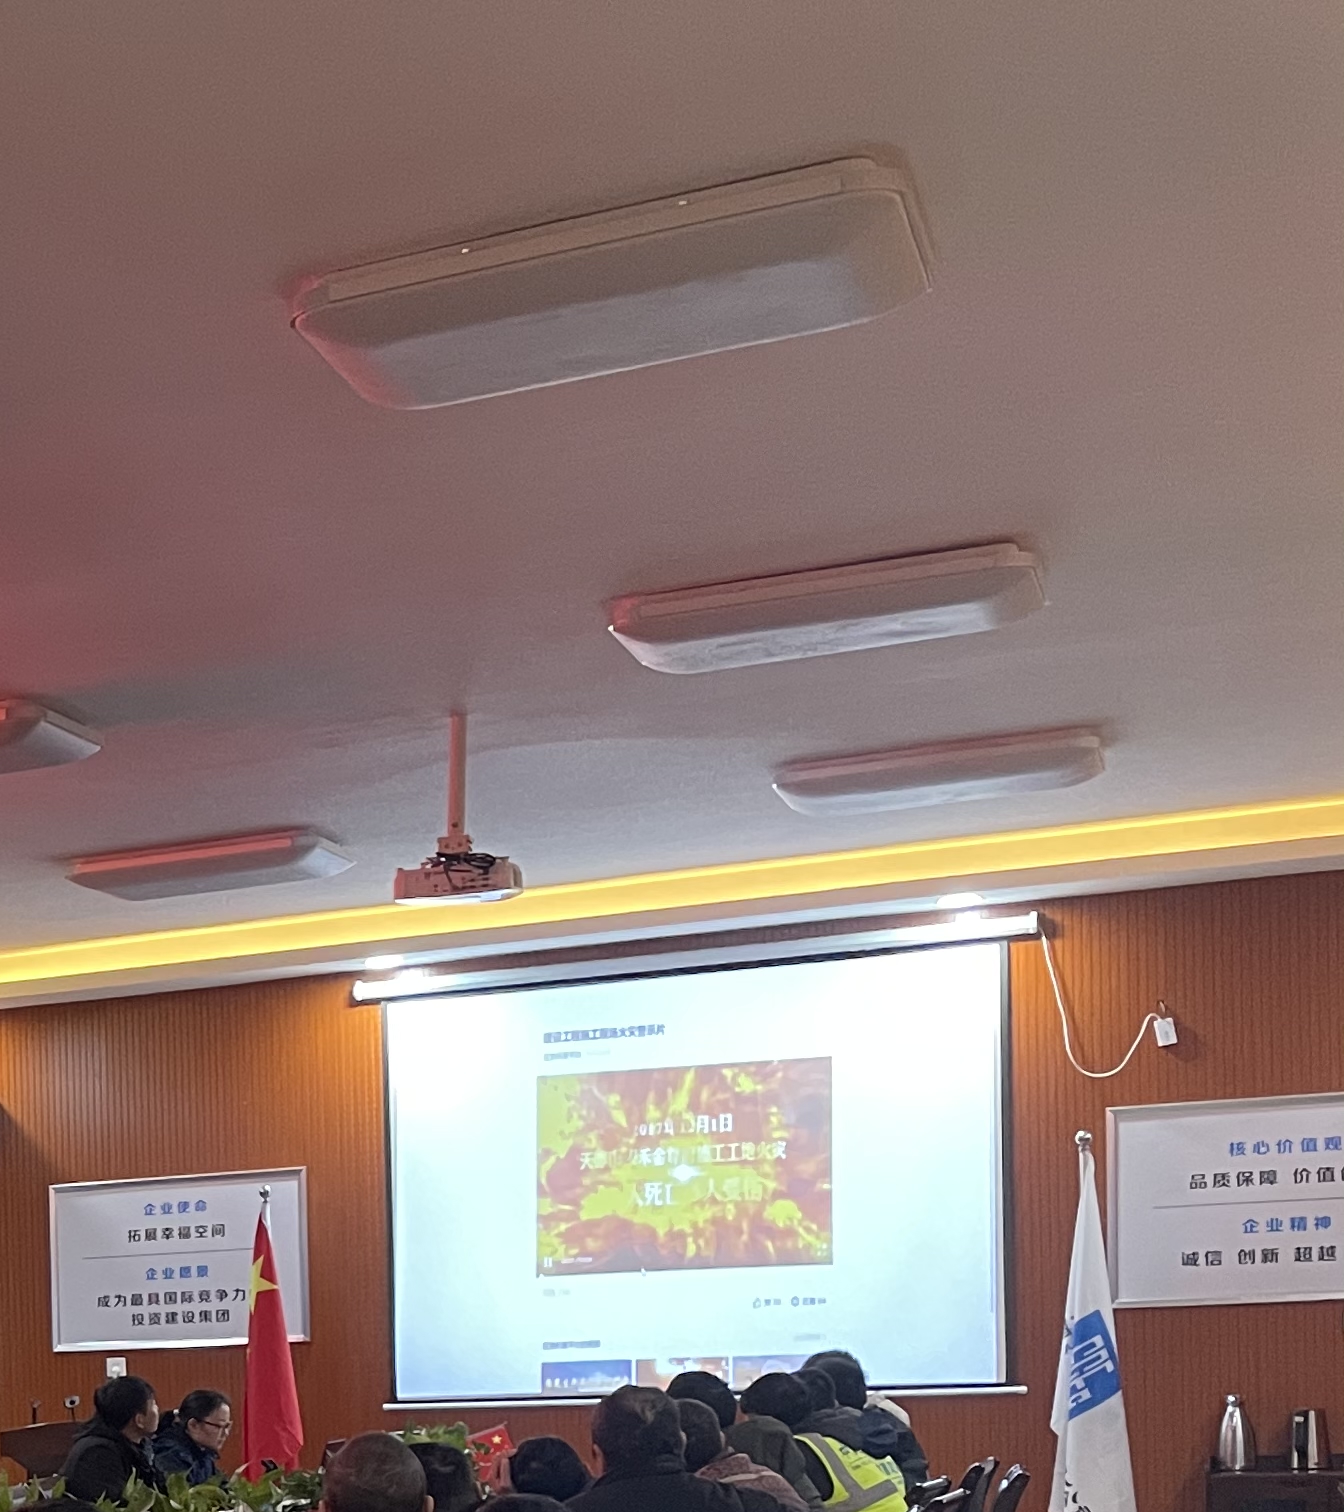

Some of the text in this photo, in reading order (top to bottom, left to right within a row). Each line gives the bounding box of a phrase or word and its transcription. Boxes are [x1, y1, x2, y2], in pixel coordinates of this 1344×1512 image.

[1228, 1136, 1342, 1157] 核心价值观
[1189, 1167, 1344, 1190] 品质保障 价值
[143, 1200, 208, 1216] 企业使命
[127, 1223, 226, 1243] 拓展幸福空间
[1242, 1215, 1332, 1234] 企业精神
[1181, 1245, 1337, 1267] 诚信 创新 超越
[145, 1265, 209, 1281] 企业愿景
[96, 1288, 252, 1308] 成为最具国际竞争力
[131, 1309, 230, 1326] 投资建设集团
